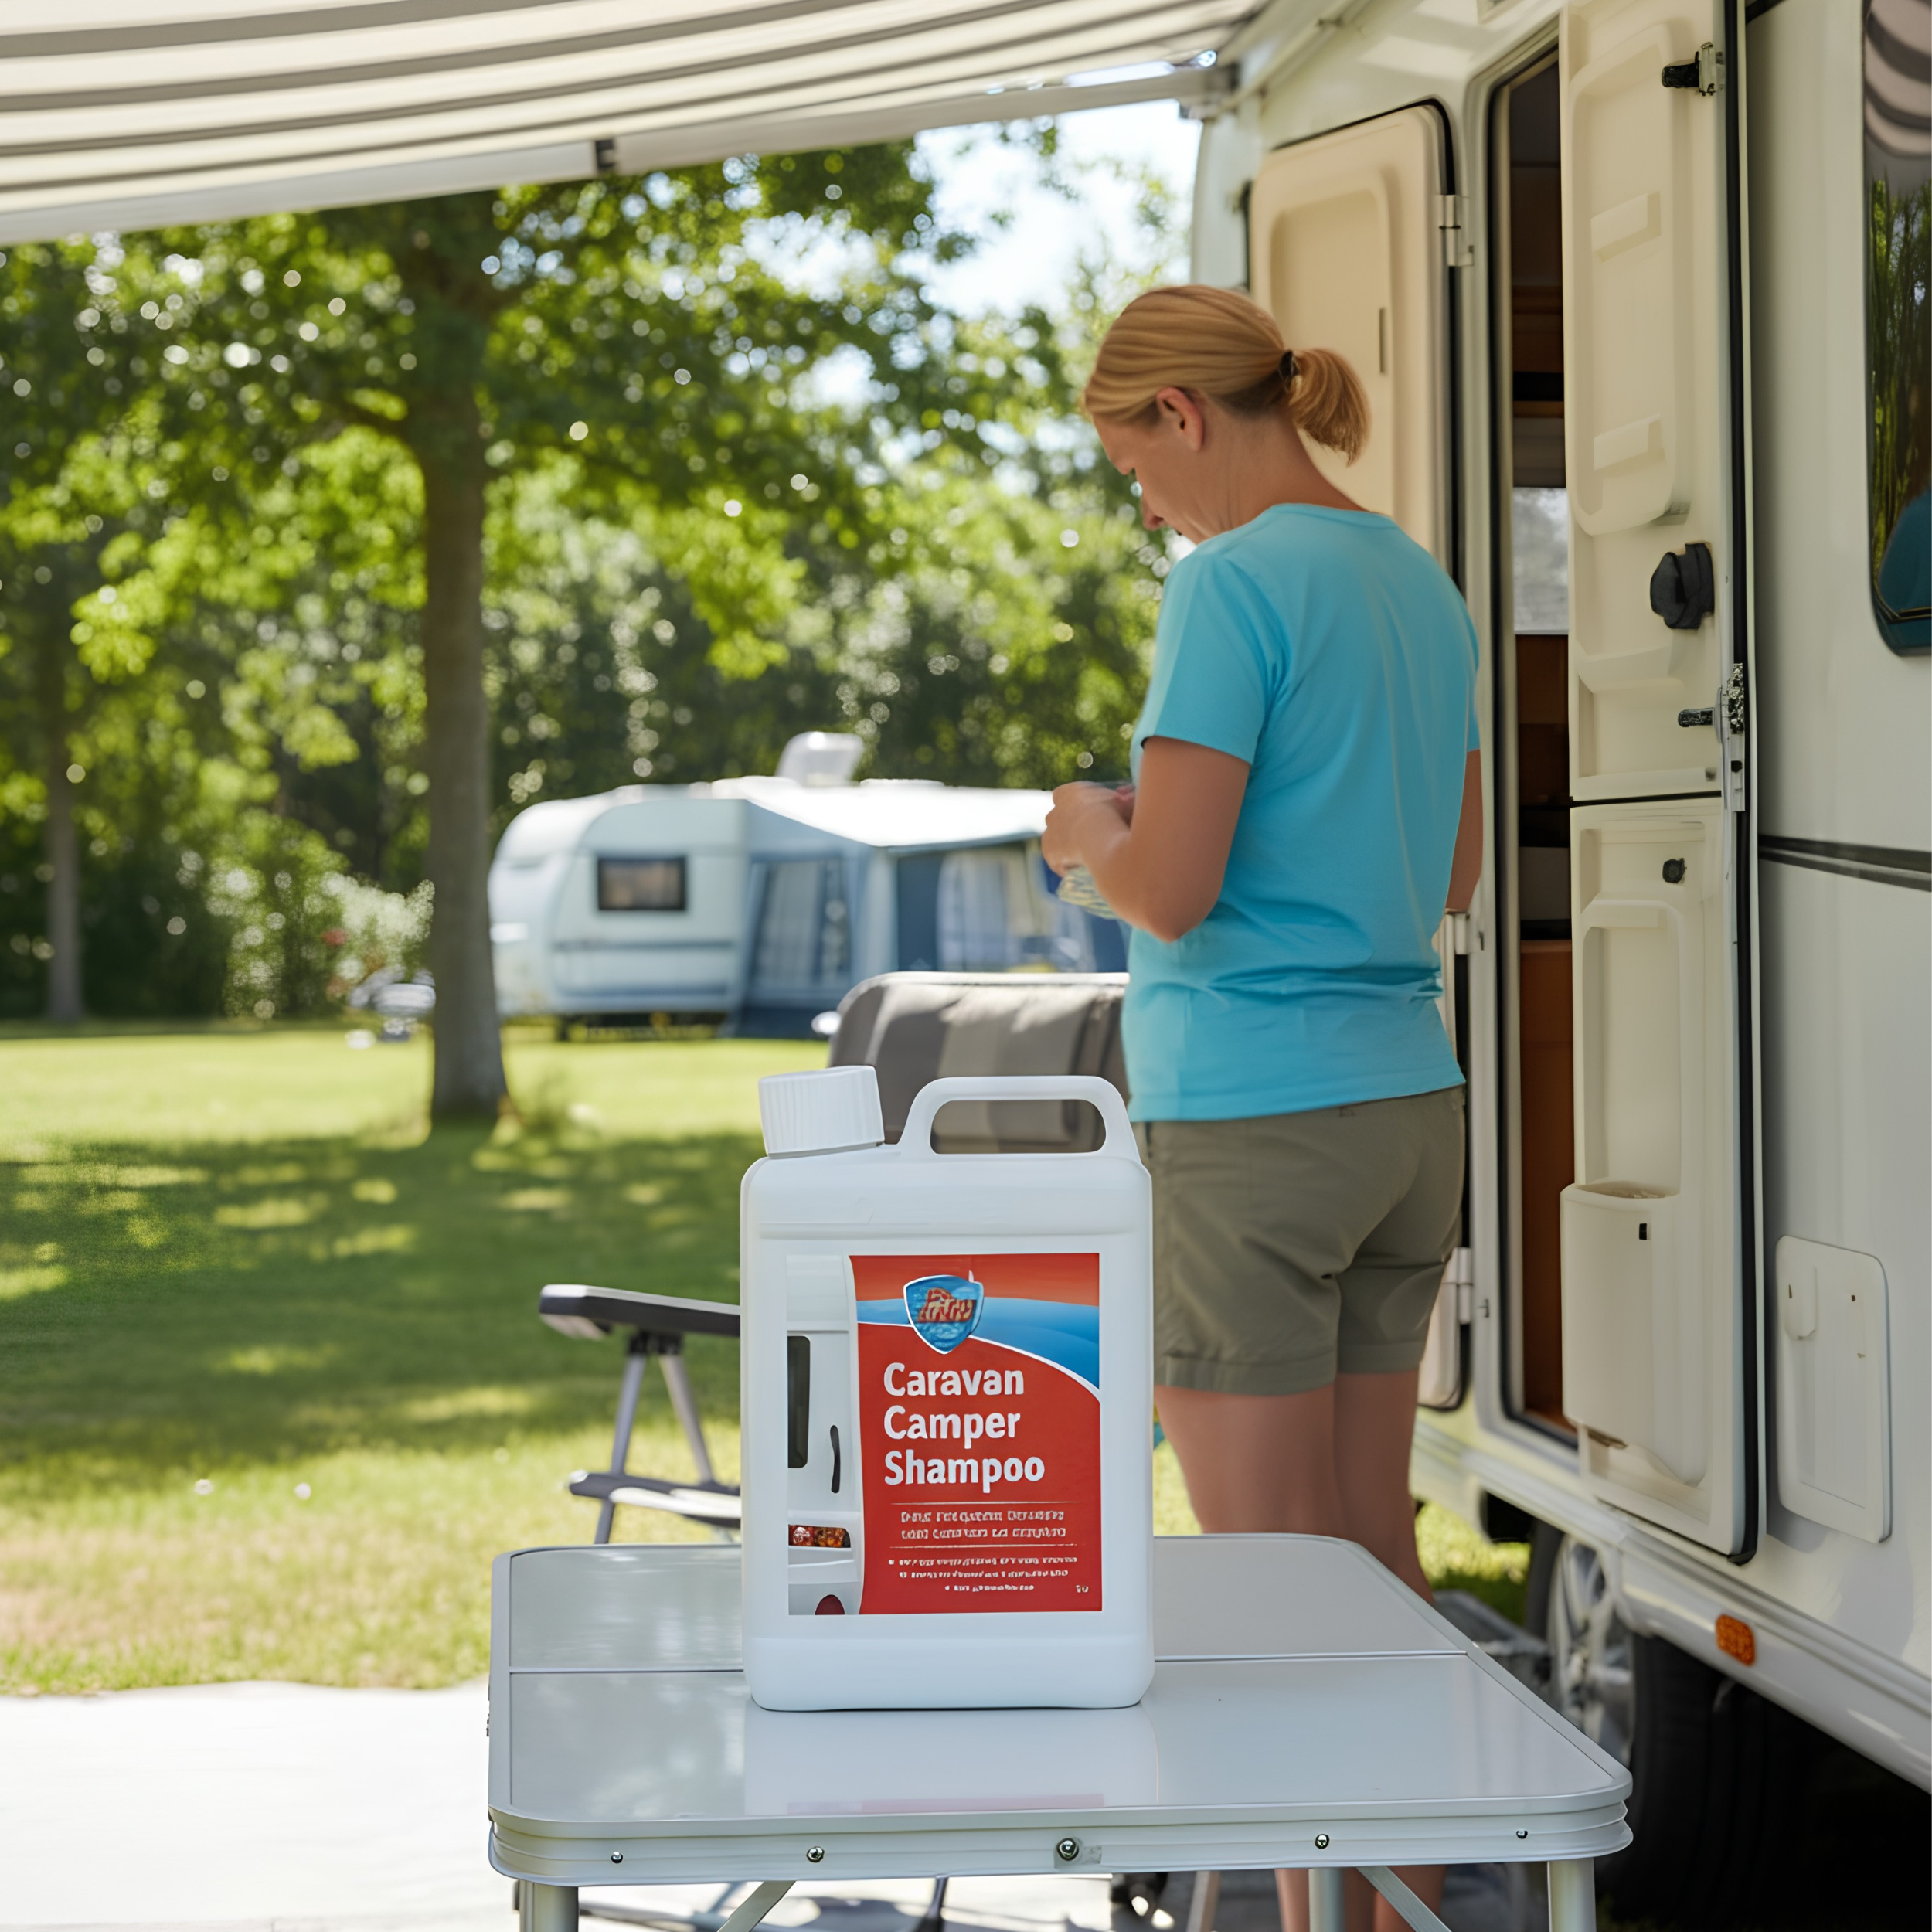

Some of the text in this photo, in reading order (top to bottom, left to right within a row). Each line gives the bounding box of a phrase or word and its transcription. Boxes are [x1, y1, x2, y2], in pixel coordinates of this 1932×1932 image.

[883, 1362, 1025, 1396] Caravan
[883, 1404, 1021, 1449] Camper
[884, 1449, 1046, 1494] Shampoo
